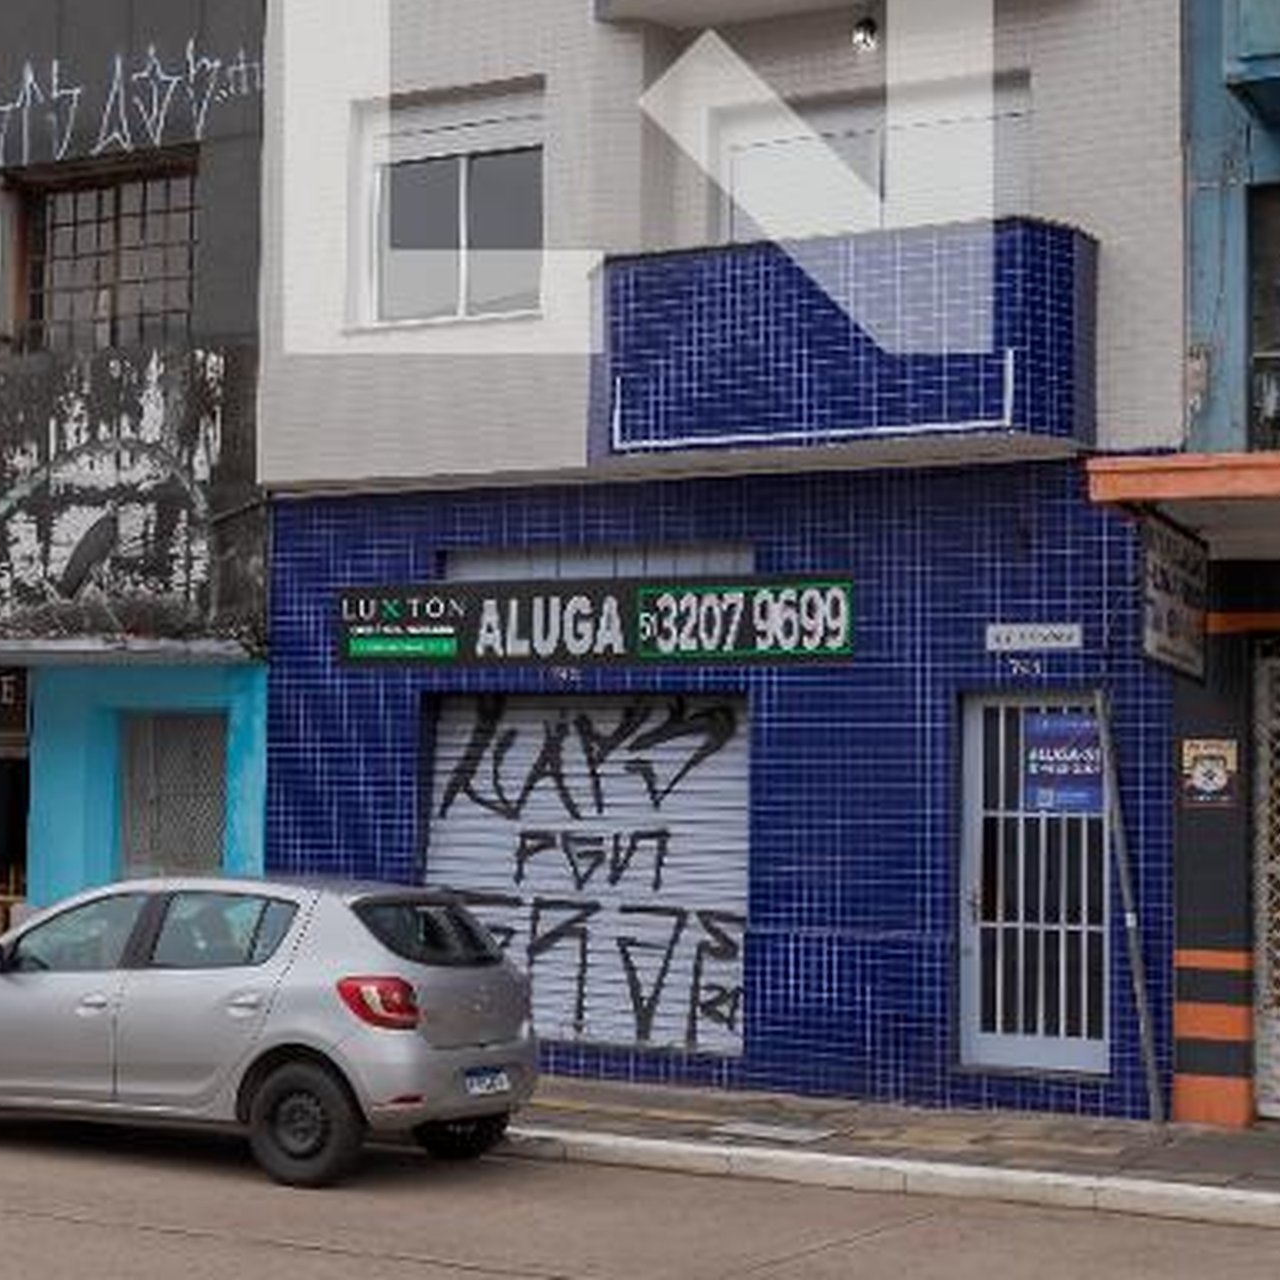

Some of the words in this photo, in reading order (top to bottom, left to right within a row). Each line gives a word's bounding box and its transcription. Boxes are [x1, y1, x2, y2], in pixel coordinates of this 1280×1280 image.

[476, 595, 625, 657] ALUGA
[655, 592, 744, 652] 3207
[752, 587, 847, 650] 9699
